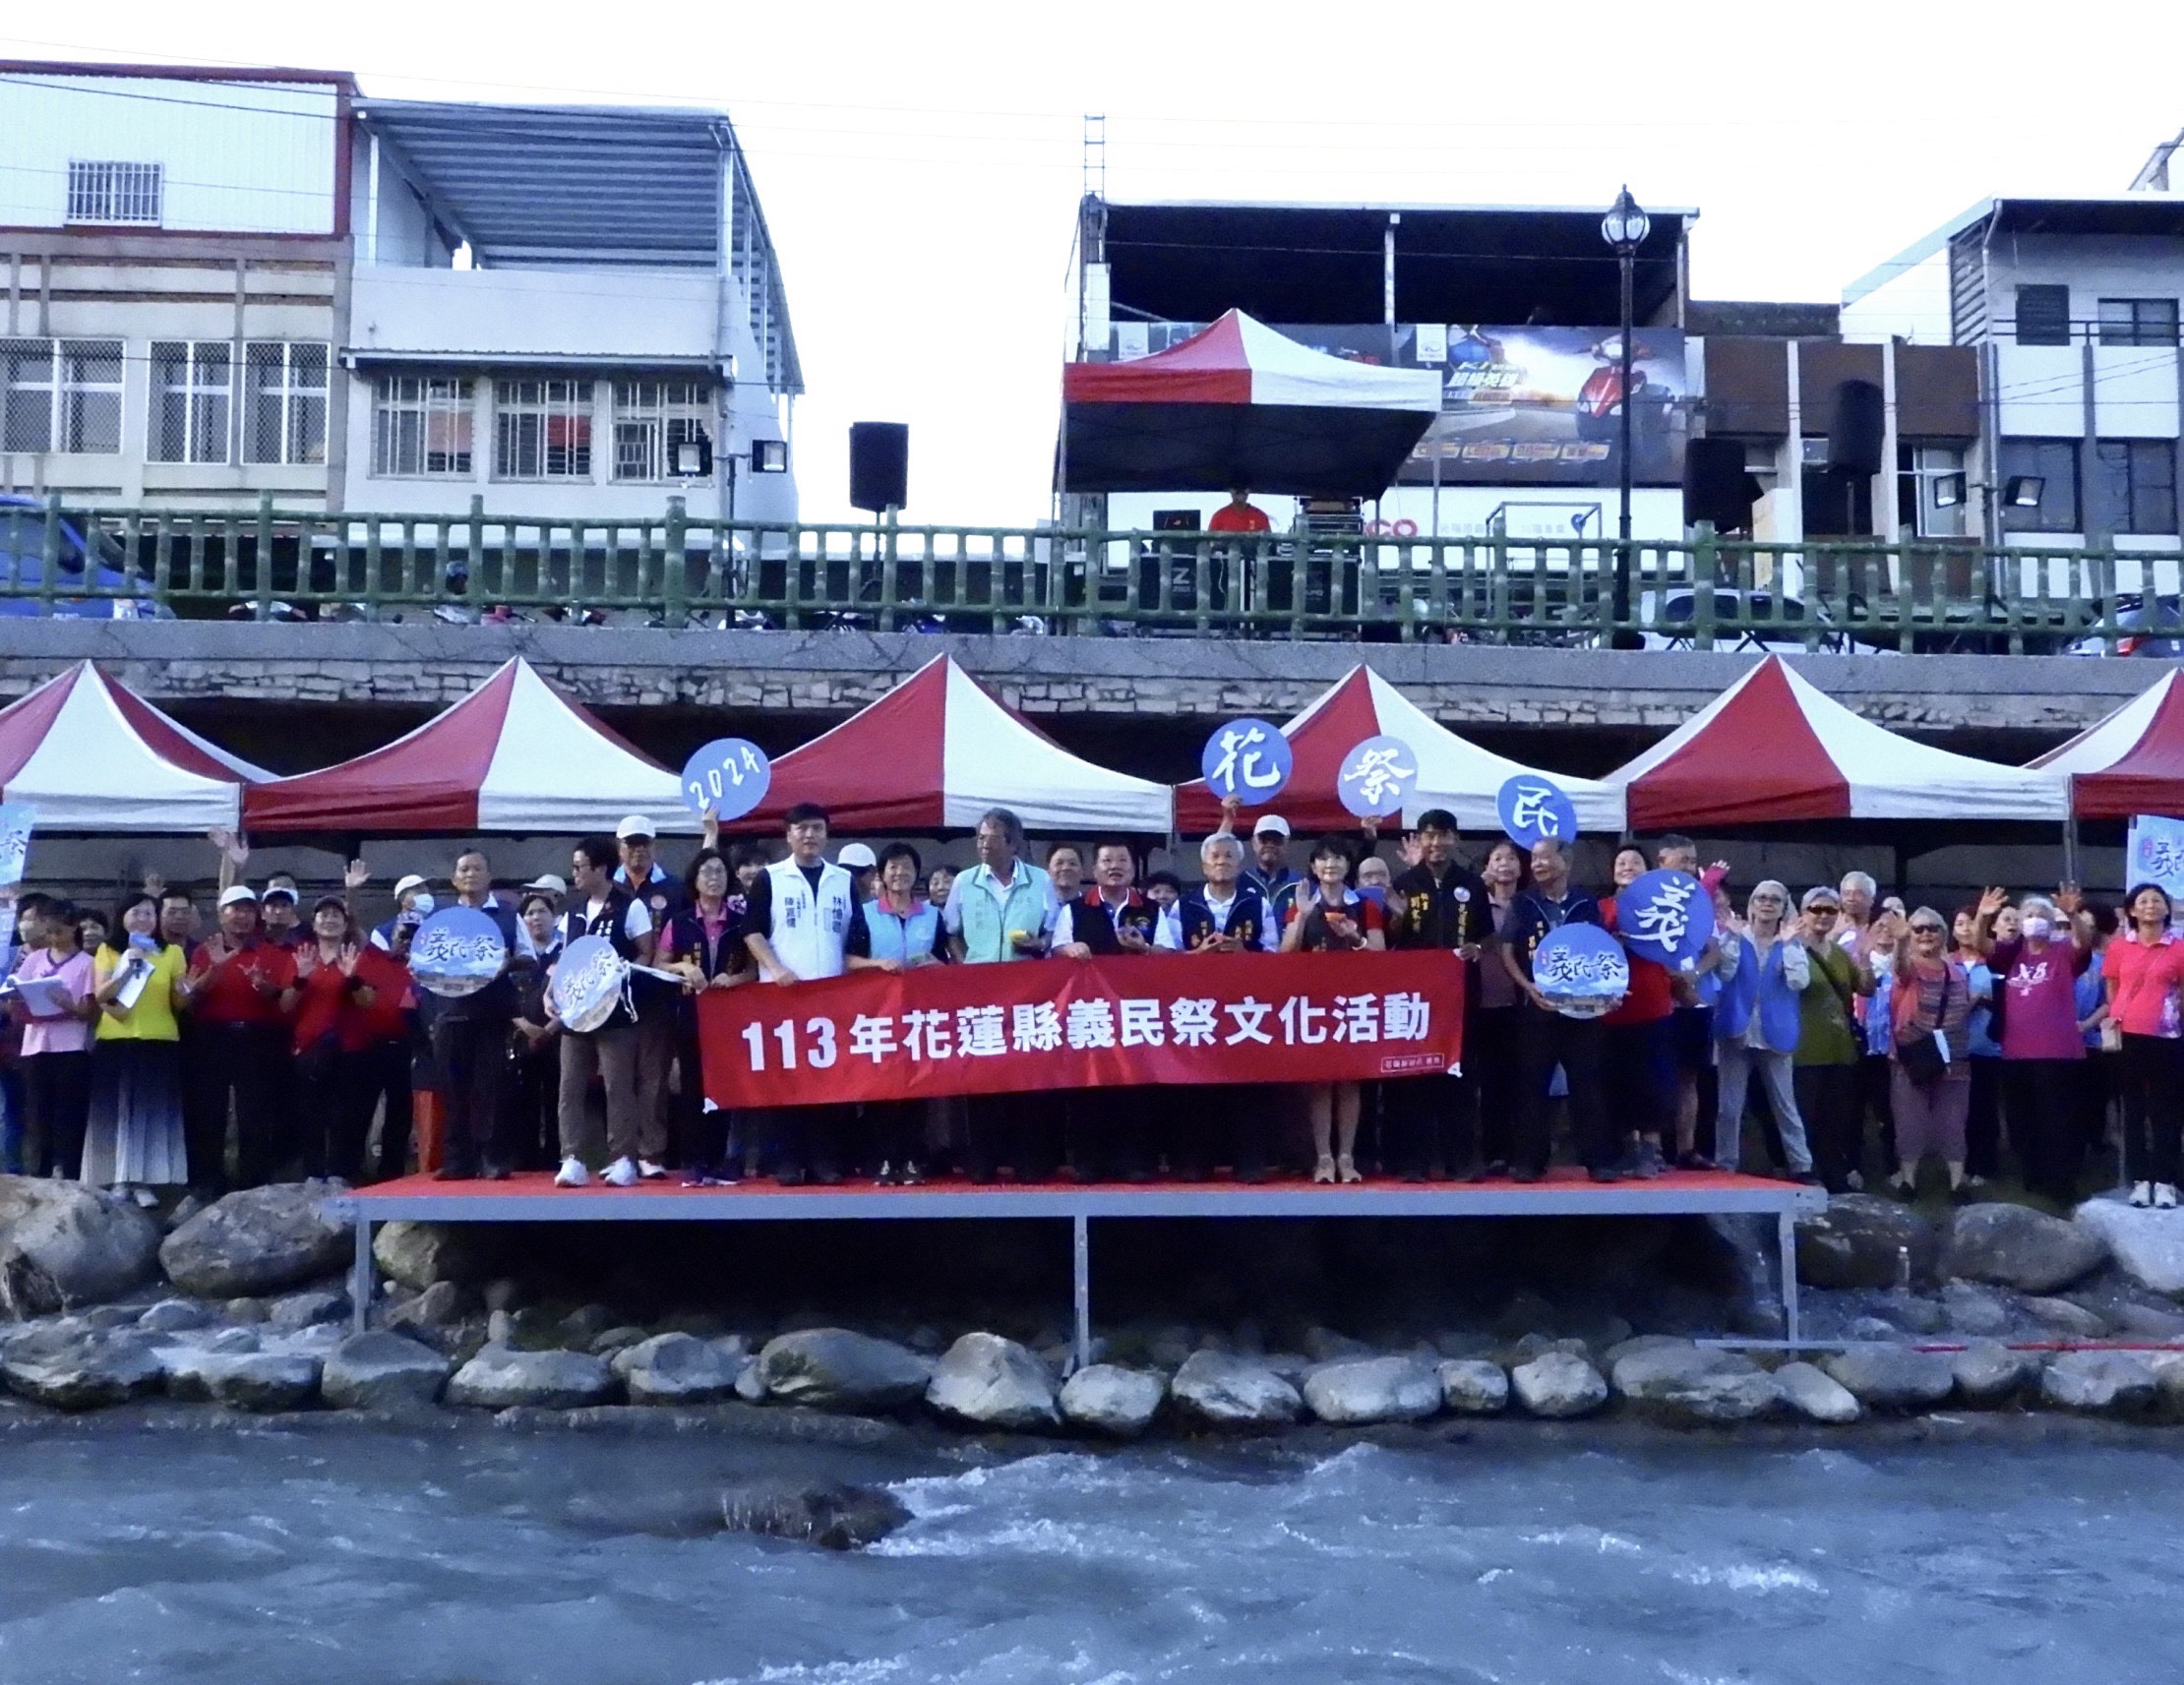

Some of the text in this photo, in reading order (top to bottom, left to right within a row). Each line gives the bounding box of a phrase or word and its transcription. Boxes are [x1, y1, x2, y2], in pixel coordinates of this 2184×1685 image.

[689, 747, 760, 810] 2024
[1212, 727, 1281, 792] 花
[1344, 749, 1415, 805] 祭
[1513, 784, 1558, 837] 民
[1629, 876, 1695, 952] 義
[425, 928, 500, 963] 義民祭
[1548, 946, 1624, 984] 義民祭
[742, 992, 1429, 1071] 113年花蓮縣義民祭文化活動
